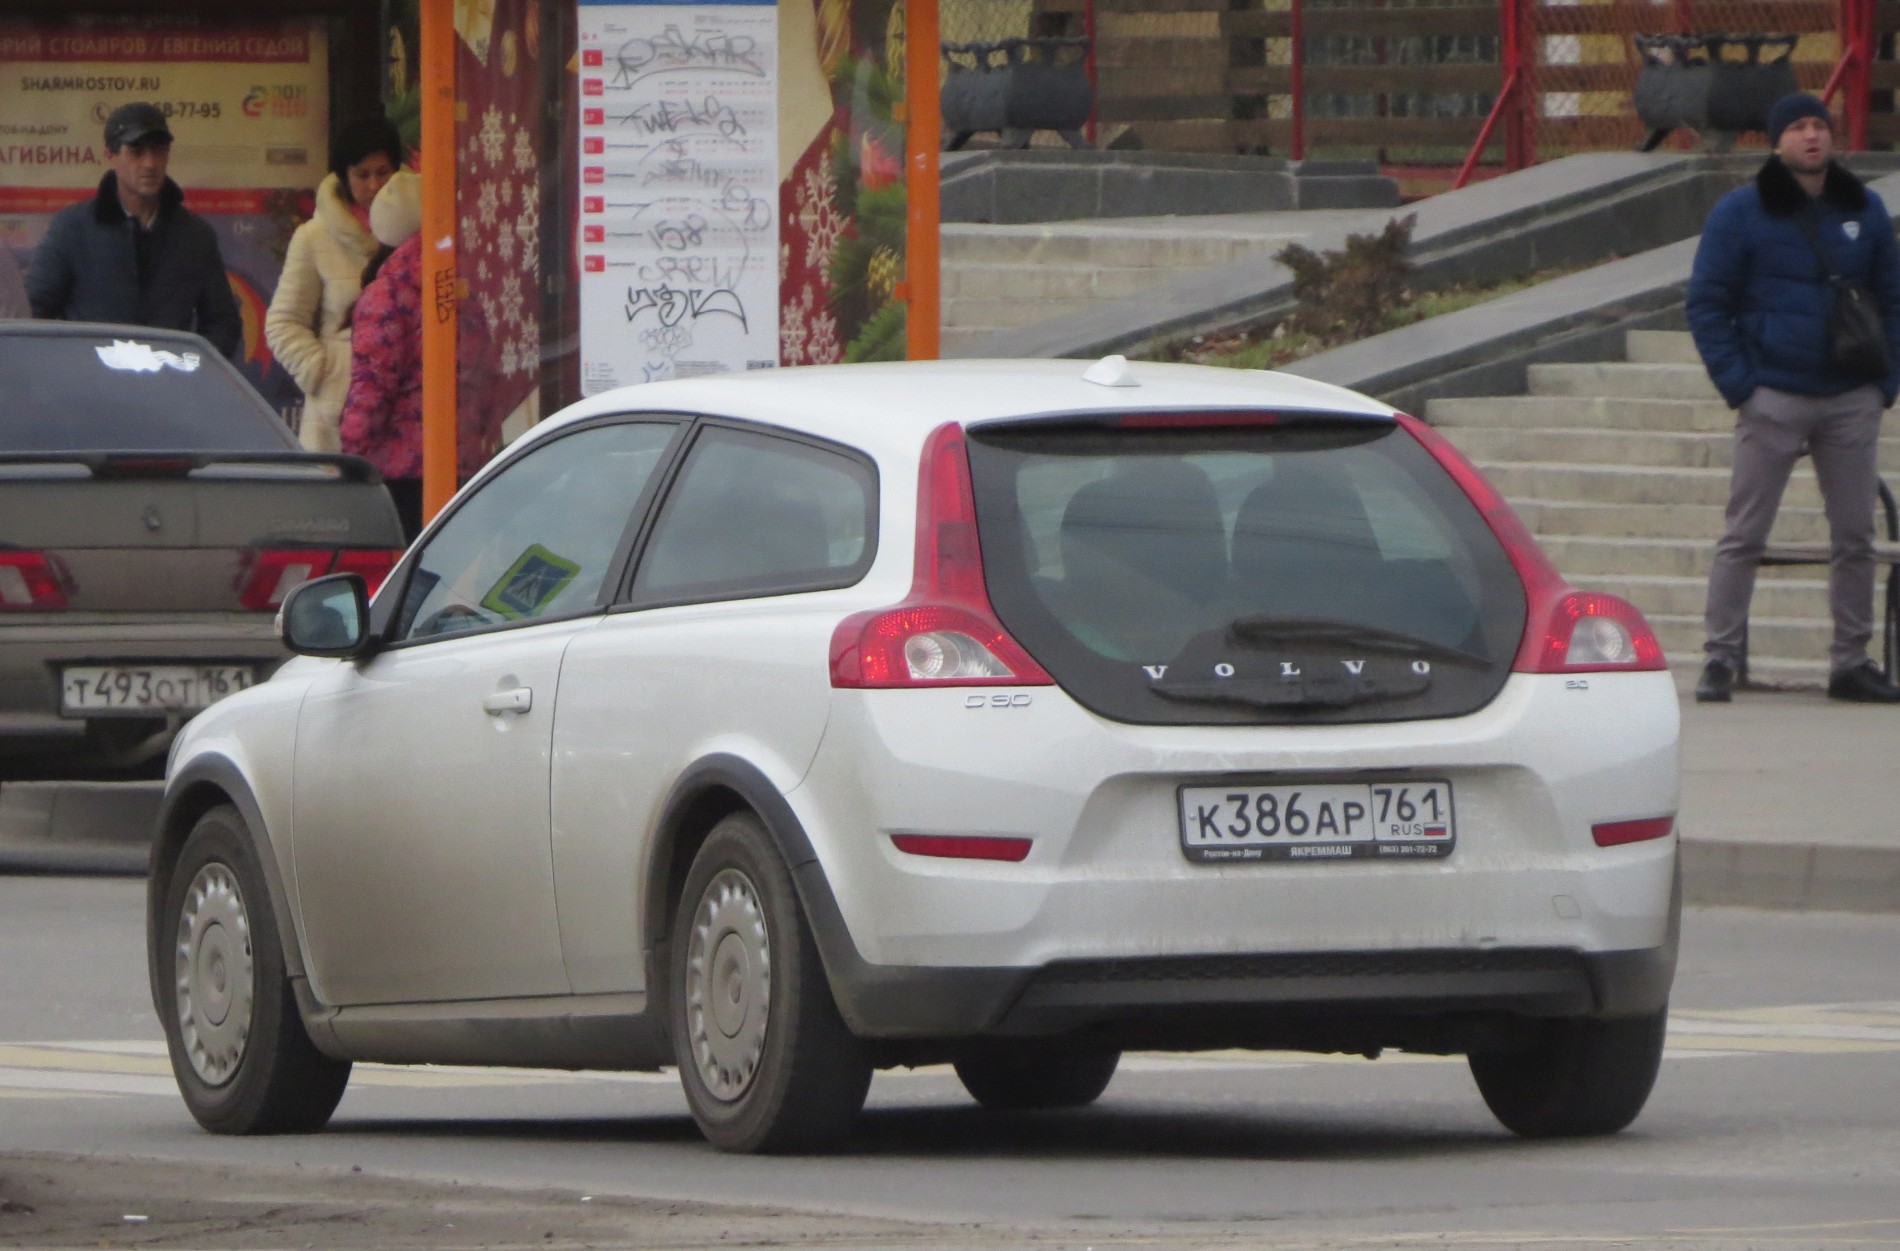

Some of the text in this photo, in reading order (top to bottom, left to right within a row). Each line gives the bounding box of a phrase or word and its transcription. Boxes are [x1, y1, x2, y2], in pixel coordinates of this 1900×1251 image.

[0, 34, 42, 54] РИЙ
[49, 36, 147, 55] СТОЛЯРОВ
[163, 34, 241, 55] ЕВГЕНИЙ
[245, 34, 304, 56] СЕДОЙ
[20, 76, 161, 91] SHARMROSTOV.RU
[1142, 660, 1432, 680] VOLVO
[965, 692, 1033, 709] C30
[1197, 788, 1440, 838] К386АР 761
[1390, 823, 1423, 837] RUS
[1290, 845, 1352, 857] ЯКРЕММАШ
